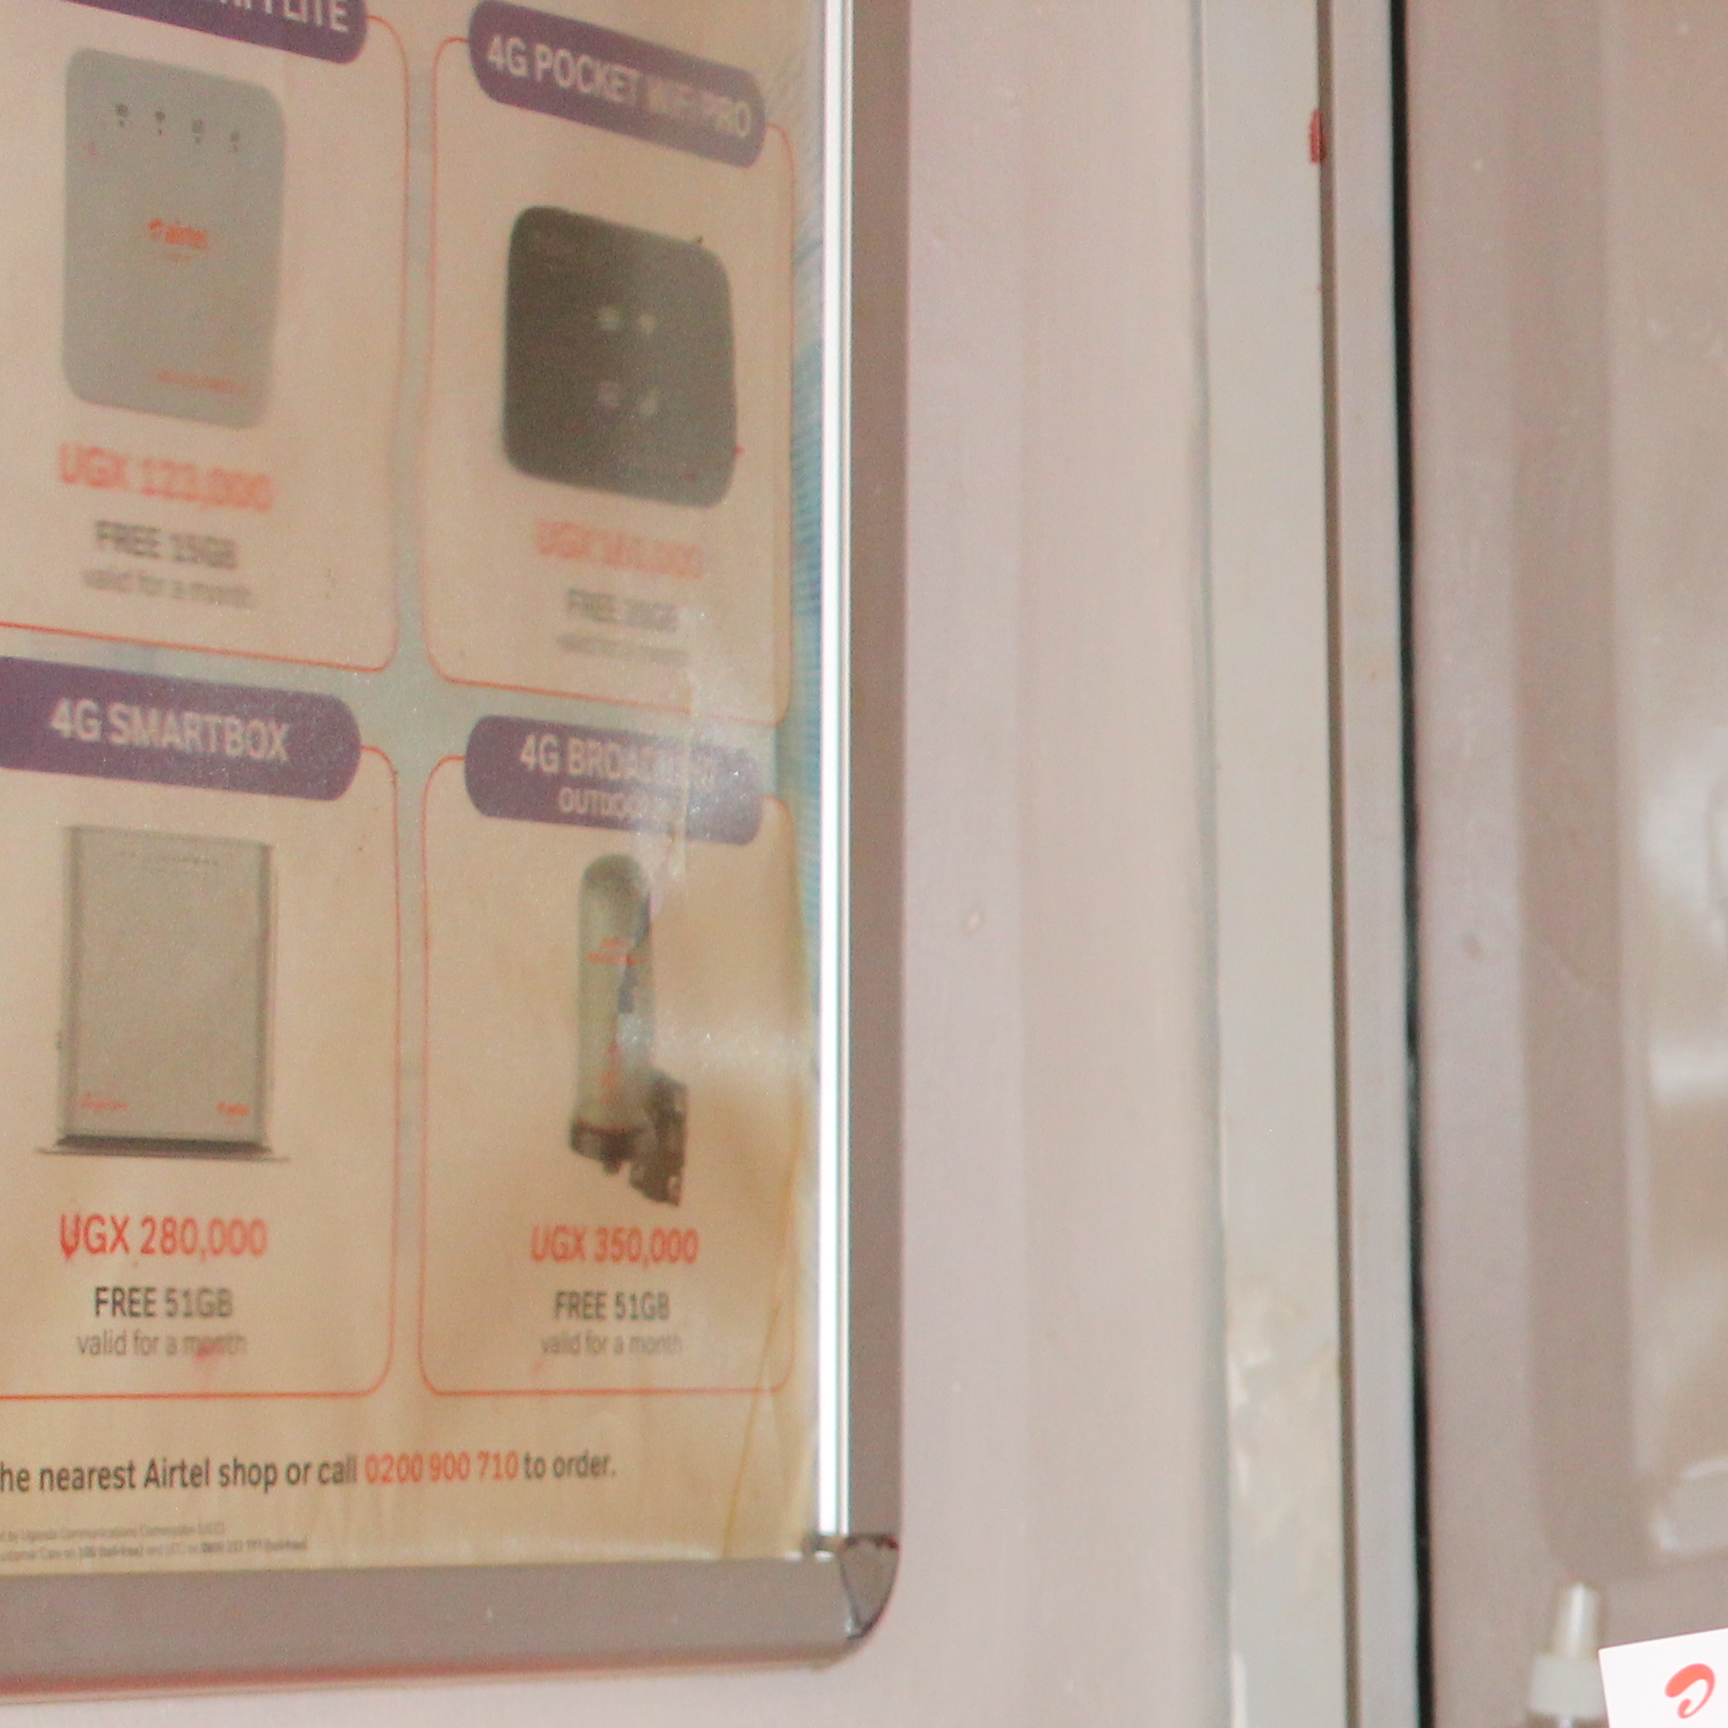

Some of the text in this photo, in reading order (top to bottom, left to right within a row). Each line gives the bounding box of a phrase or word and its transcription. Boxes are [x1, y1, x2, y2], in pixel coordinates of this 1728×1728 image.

[486, 34, 527, 77] 4G
[534, 43, 642, 103] POCKET
[93, 518, 161, 560] FREE
[50, 697, 291, 763] 4G SMARTBOX
[519, 733, 559, 775] 4G
[59, 1212, 269, 1262] UGX 280,000
[531, 1225, 700, 1270] UGX 350,000
[94, 1286, 234, 1319] FREE 51GB
[554, 1290, 671, 1321] FREE 51GB
[76, 1330, 128, 1356] valid
[133, 1329, 159, 1356] for
[164, 1335, 178, 1355] a
[541, 1333, 582, 1355] valid
[584, 1331, 609, 1354] for
[613, 1335, 625, 1354] a
[0, 1450, 617, 1495] he nearest Airtel shop or call 0200 900 710 to order.
